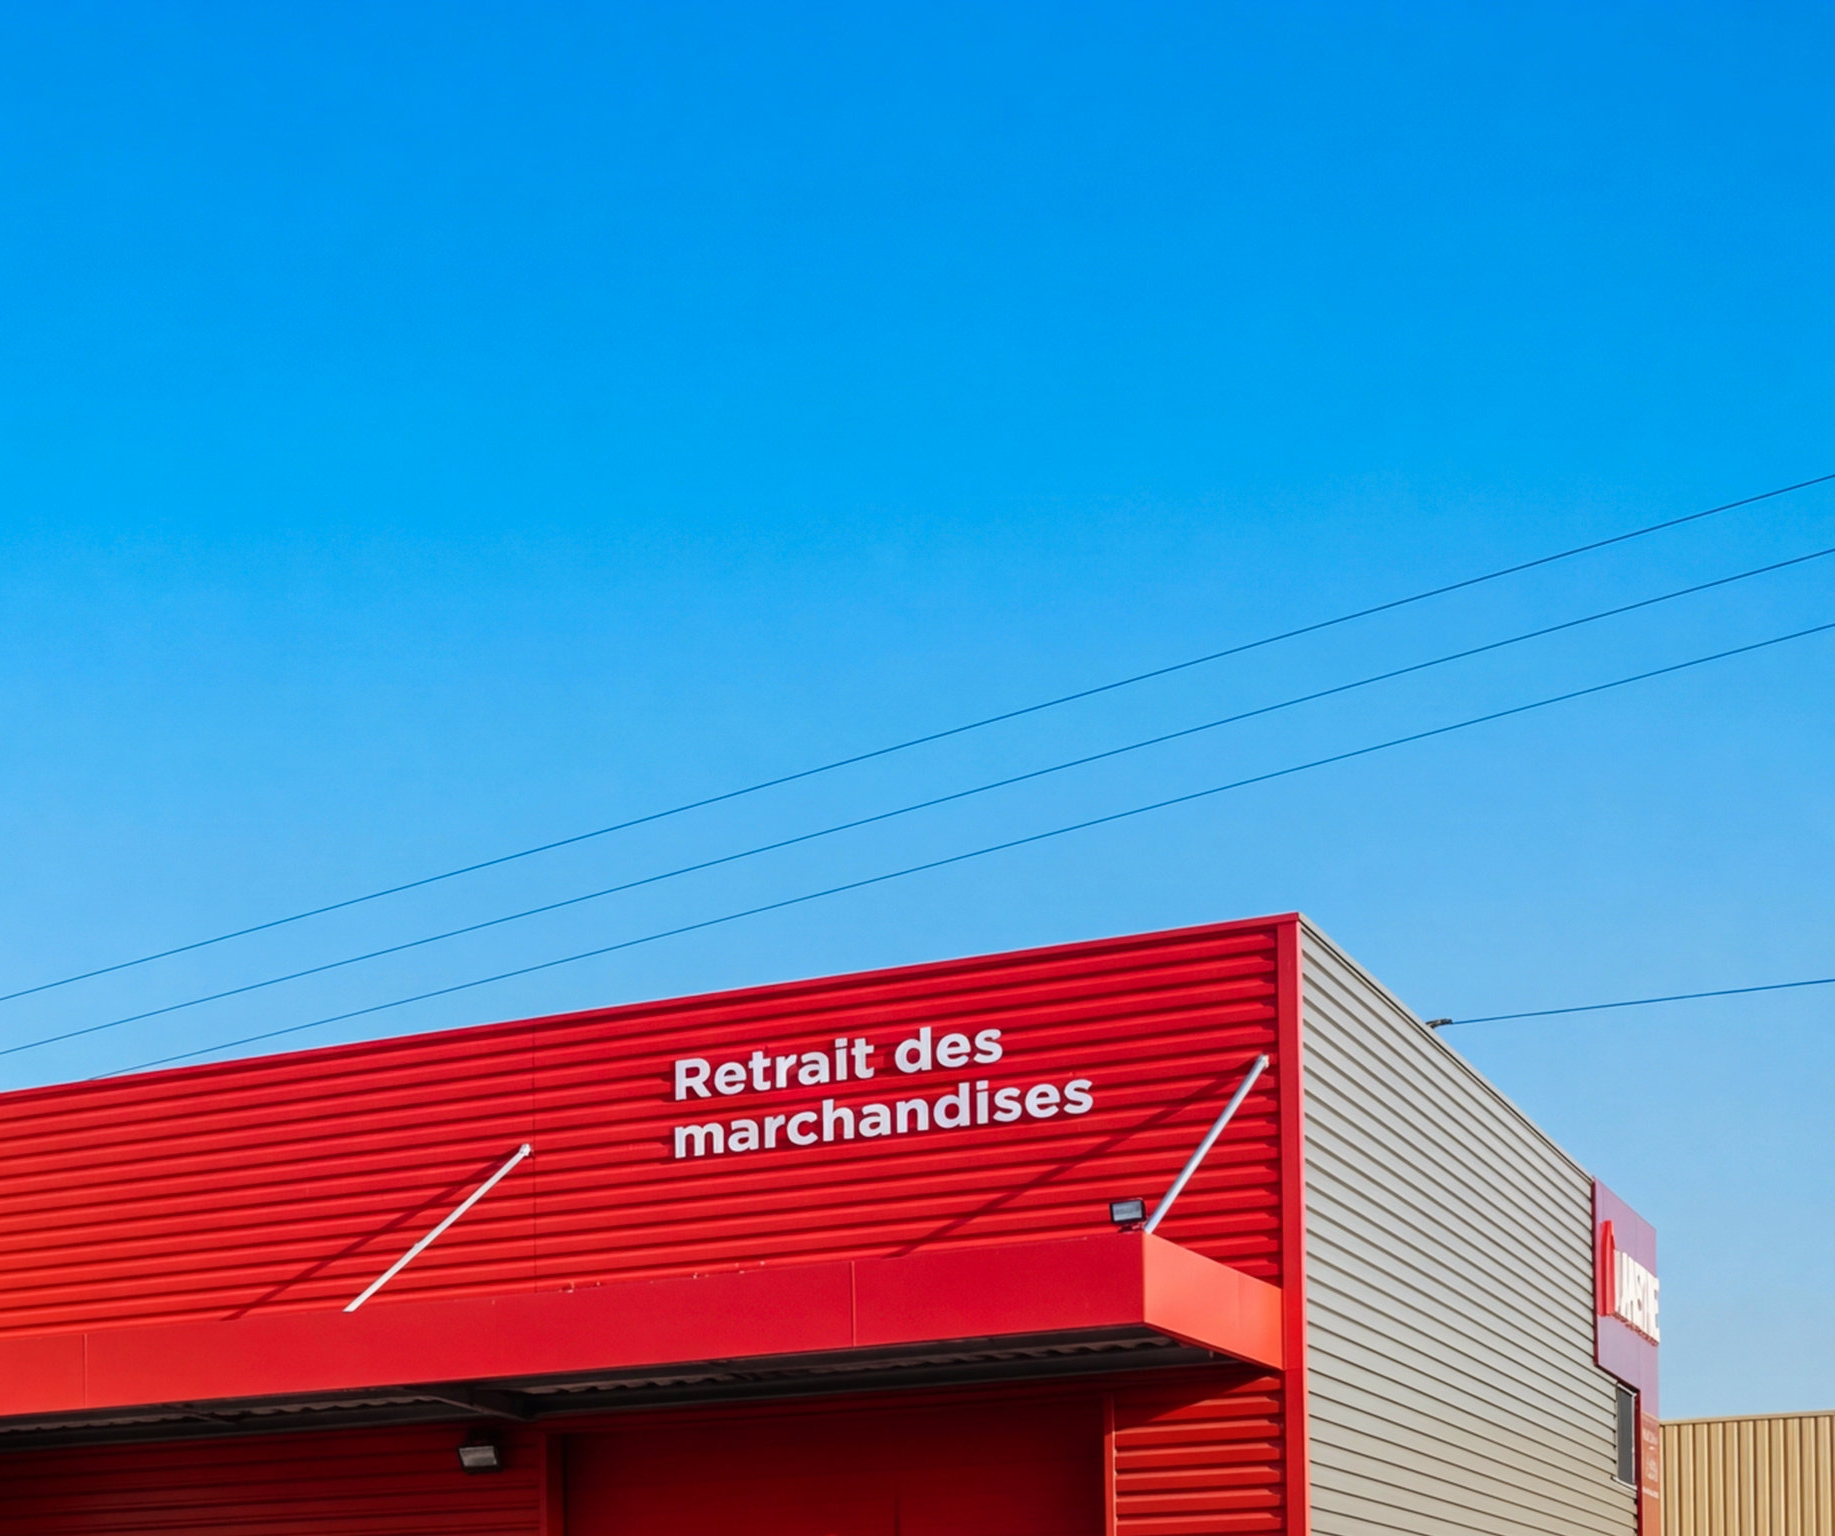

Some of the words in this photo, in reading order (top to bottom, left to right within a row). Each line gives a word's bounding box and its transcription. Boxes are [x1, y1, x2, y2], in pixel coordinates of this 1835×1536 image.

[674, 1036, 875, 1101] Retrait
[893, 1026, 1004, 1075] des
[673, 1077, 1094, 1159] marchandises
